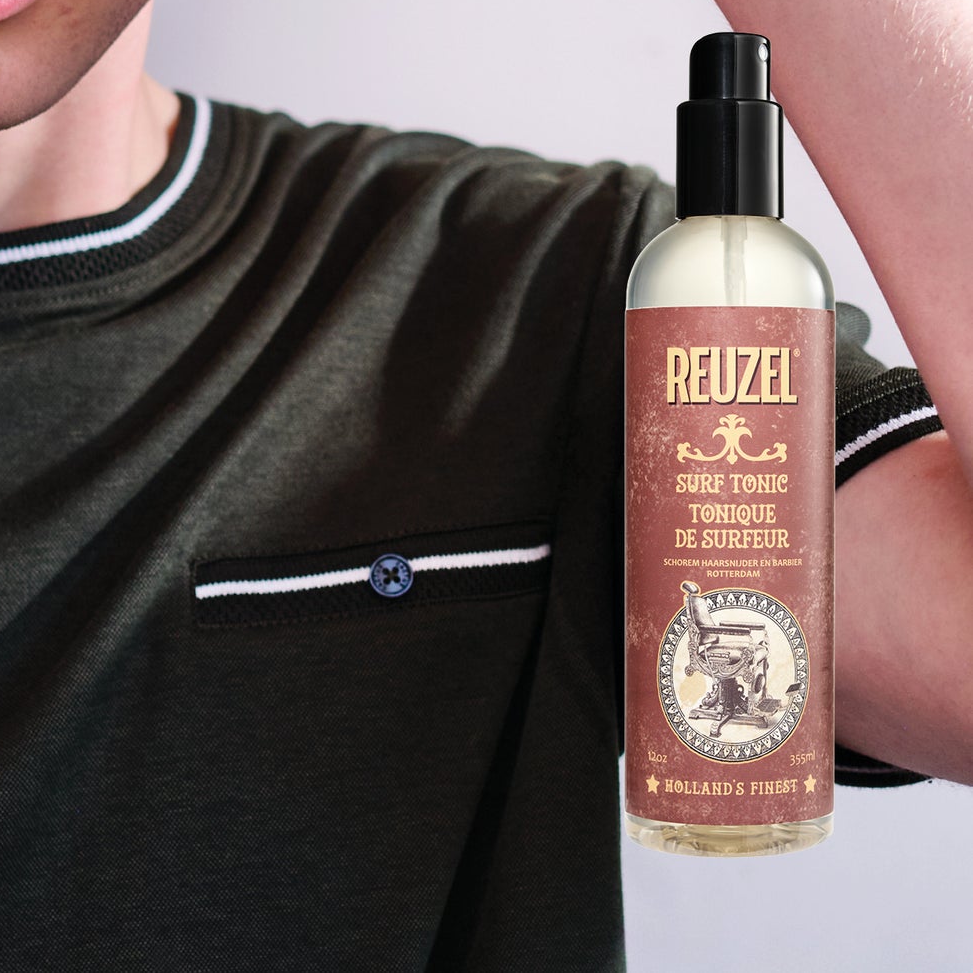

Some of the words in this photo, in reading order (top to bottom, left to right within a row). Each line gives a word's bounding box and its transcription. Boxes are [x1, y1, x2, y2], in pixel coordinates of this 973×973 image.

[676, 473, 724, 493] SURF
[729, 473, 788, 493] TONIC
[688, 504, 776, 526] TONIQUE
[674, 529, 697, 548] DE
[701, 529, 790, 549] SURFEUR
[663, 558, 700, 567] SCHOREM
[701, 559, 759, 568] HAARSNIJDER
[760, 559, 771, 567] EN
[772, 558, 803, 567] BARBIER
[706, 570, 761, 578] ROTTERDAM
[648, 750, 668, 763] 12oz
[789, 750, 816, 766] 355ml
[664, 778, 745, 796] HOLLAND'S
[750, 778, 798, 795] FINEST
